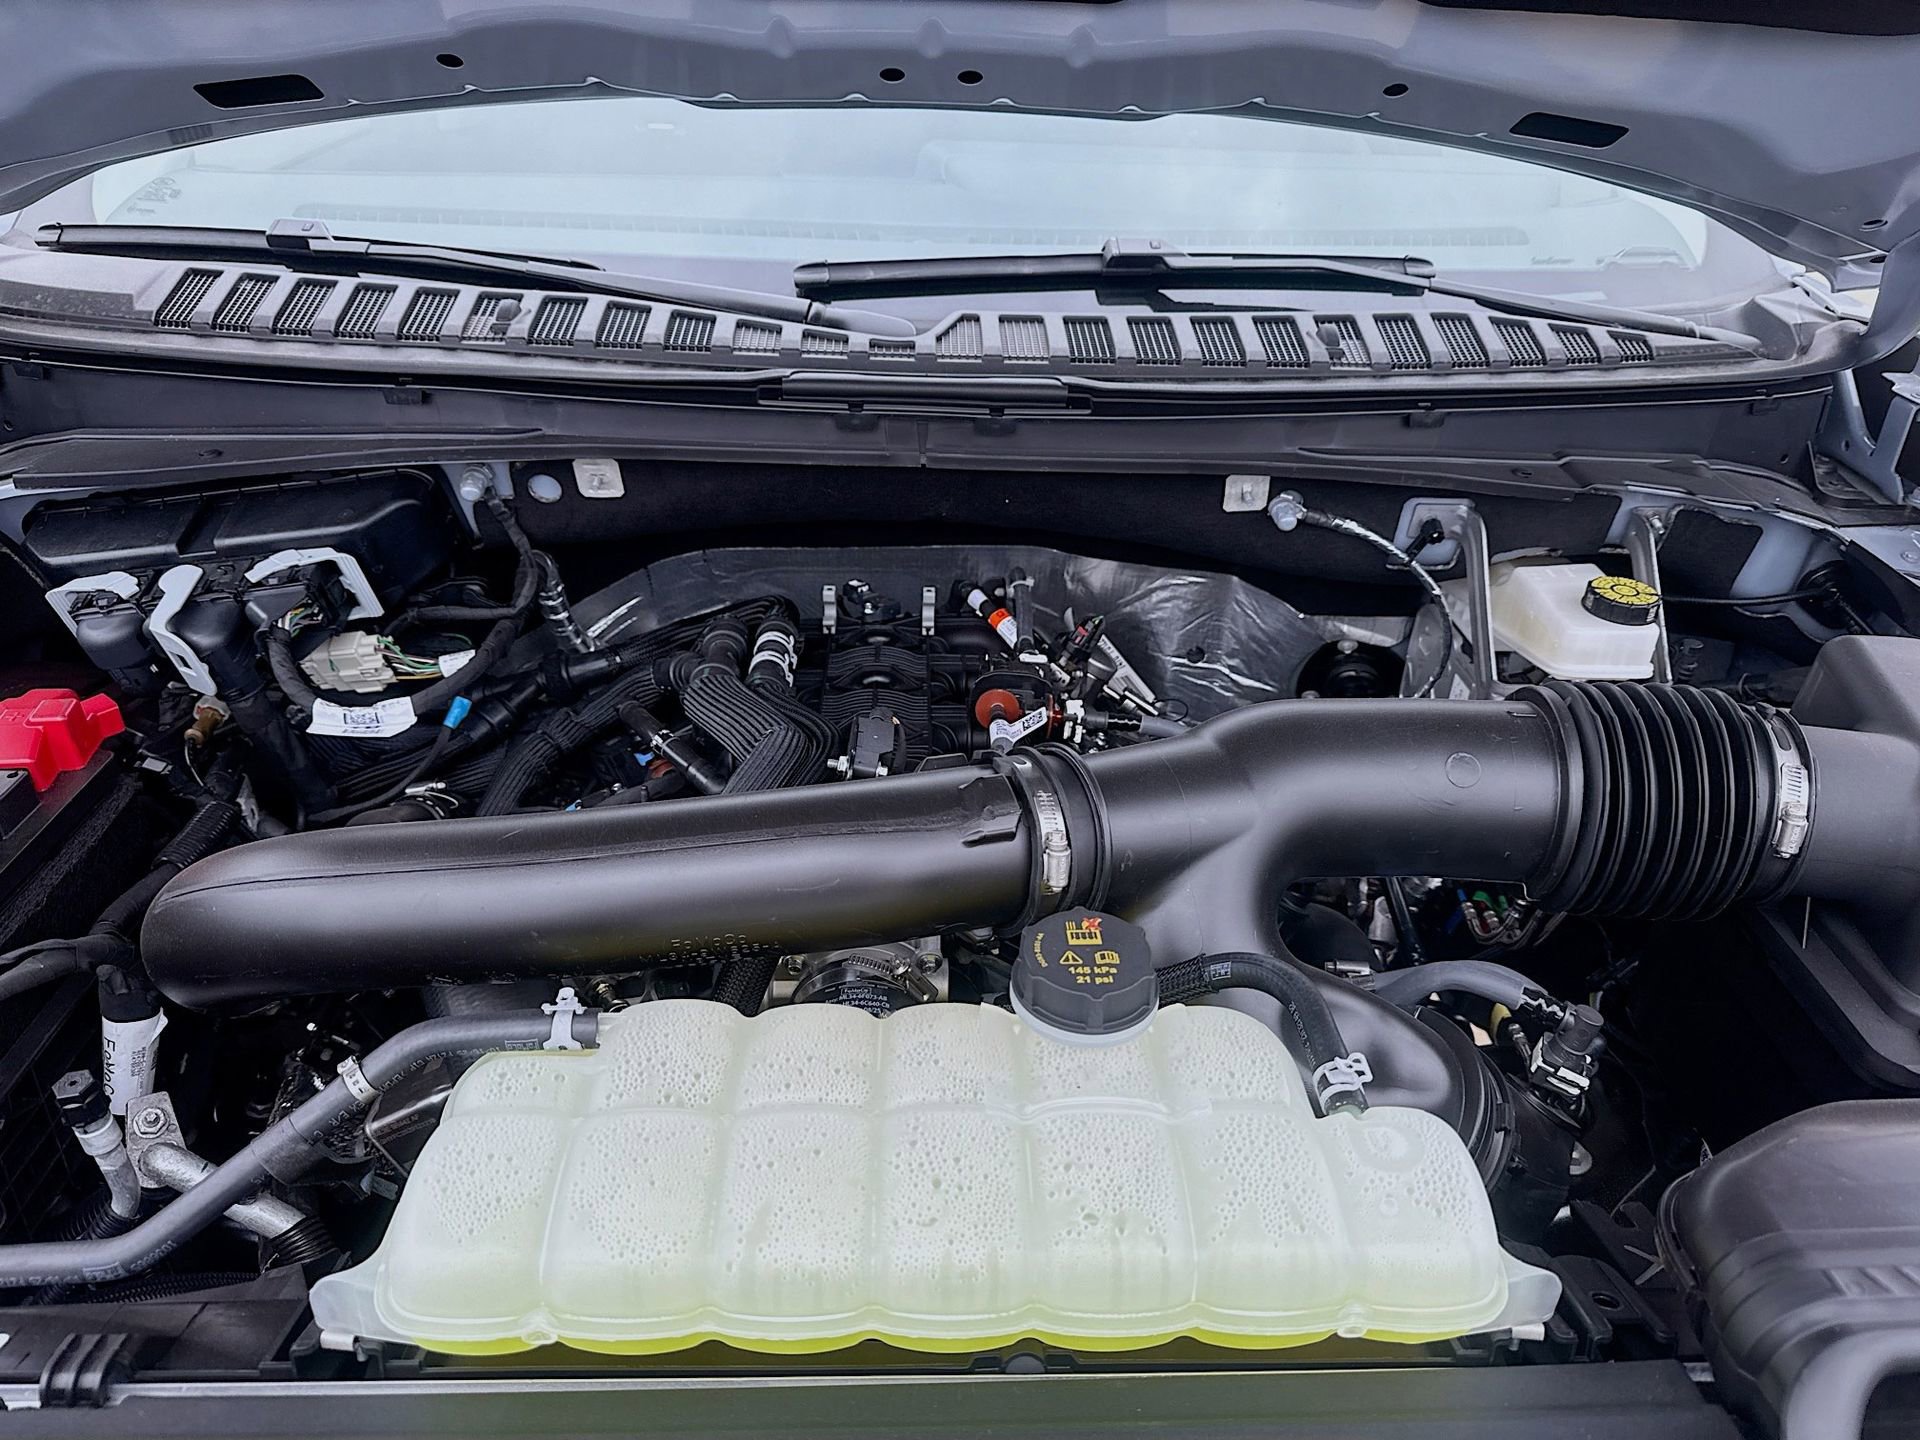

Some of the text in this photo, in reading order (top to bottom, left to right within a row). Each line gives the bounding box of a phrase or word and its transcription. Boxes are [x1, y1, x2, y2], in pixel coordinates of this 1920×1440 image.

[1068, 966, 1091, 974] 145
[1095, 976, 1113, 984] psi
[103, 1036, 116, 1095] FoMoC
